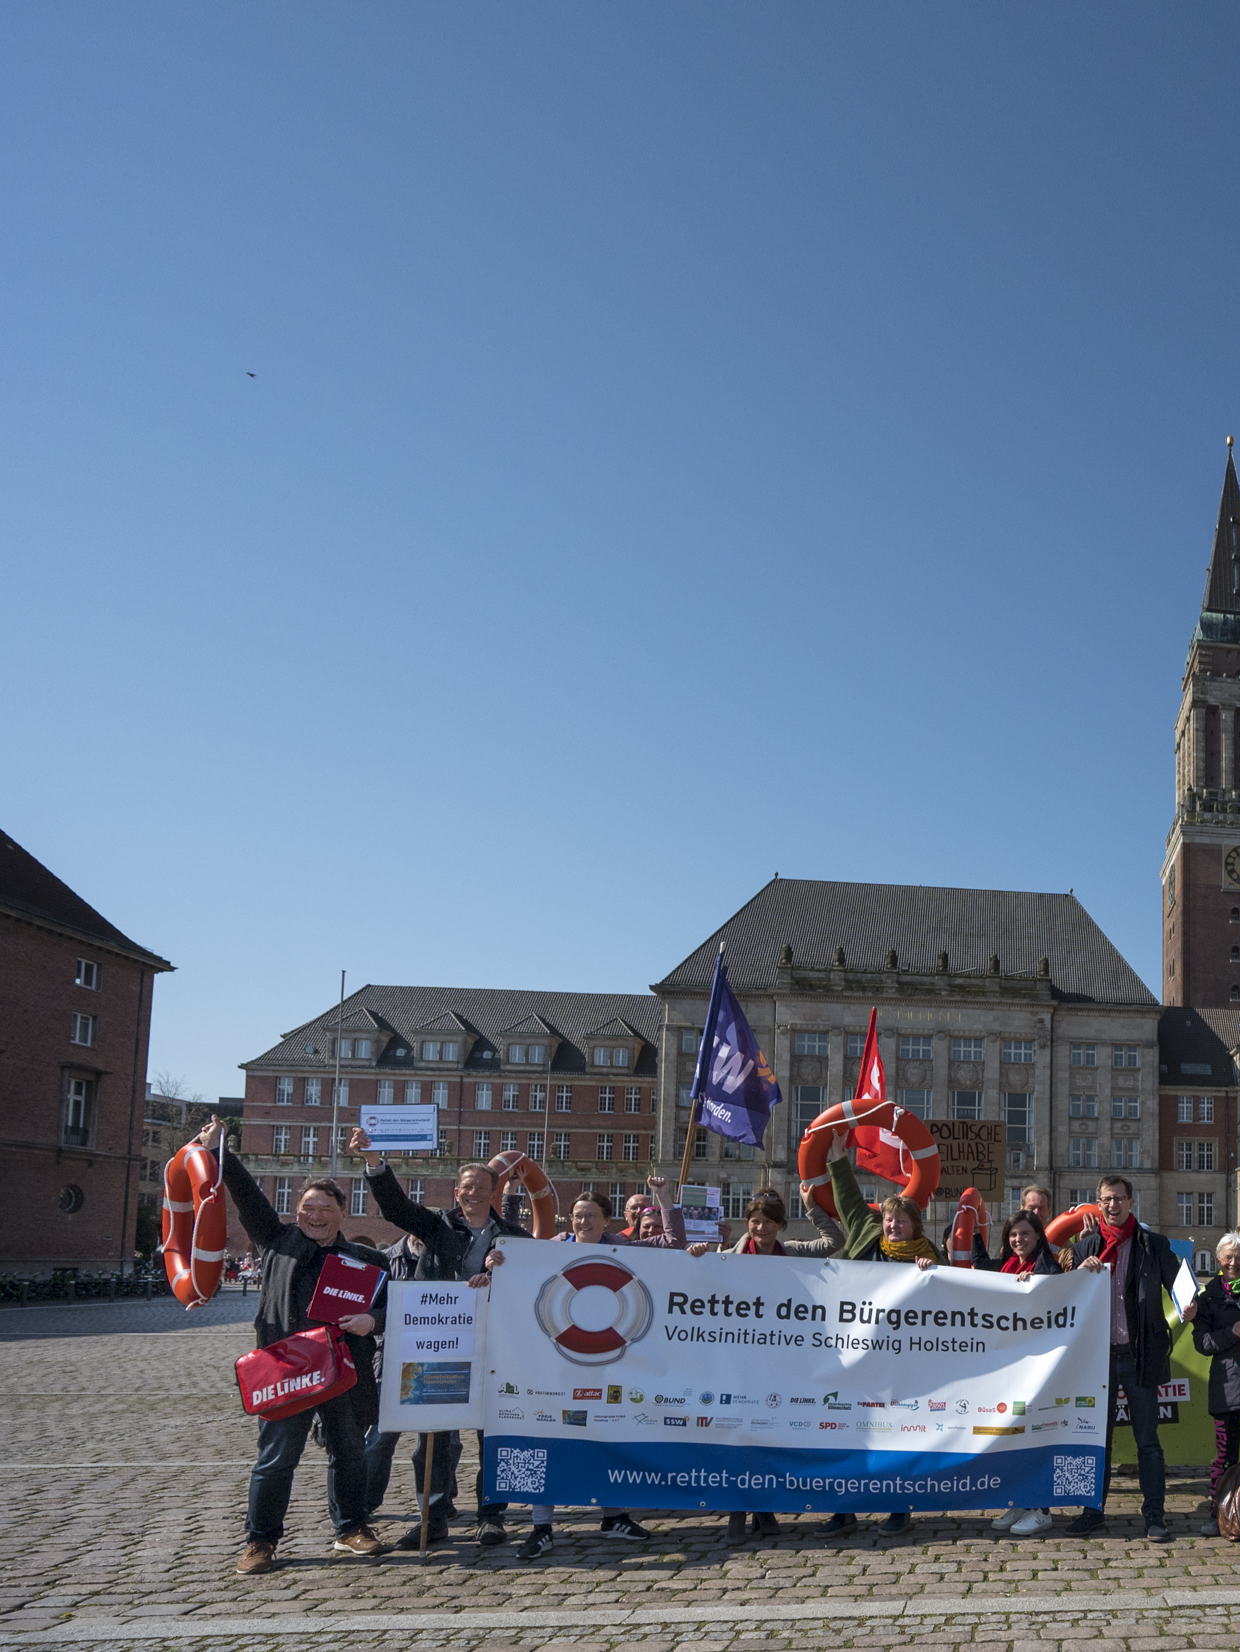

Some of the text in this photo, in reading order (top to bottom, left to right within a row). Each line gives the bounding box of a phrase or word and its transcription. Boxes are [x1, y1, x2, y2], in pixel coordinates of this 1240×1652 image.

[930, 1121, 1002, 1142] POLITISCHE
[937, 1142, 995, 1162] EILHABE
[323, 1286, 338, 1297] DIE
[420, 1293, 459, 1305] #Mehr
[668, 1291, 1077, 1331] Rettet den Bürgerentscheid!
[404, 1313, 473, 1325] Demokratie
[416, 1337, 459, 1352] wagen!
[664, 1325, 986, 1355] Volksinitiative Schleswig Holstein
[252, 1387, 275, 1406] DIE
[664, 1396, 686, 1404] BUND
[665, 1418, 684, 1426] SSW
[818, 1421, 837, 1430] SPD
[856, 1420, 893, 1428] OMNIBUS
[608, 1468, 1001, 1495] www.rettet-den-buergerentscheid.de
